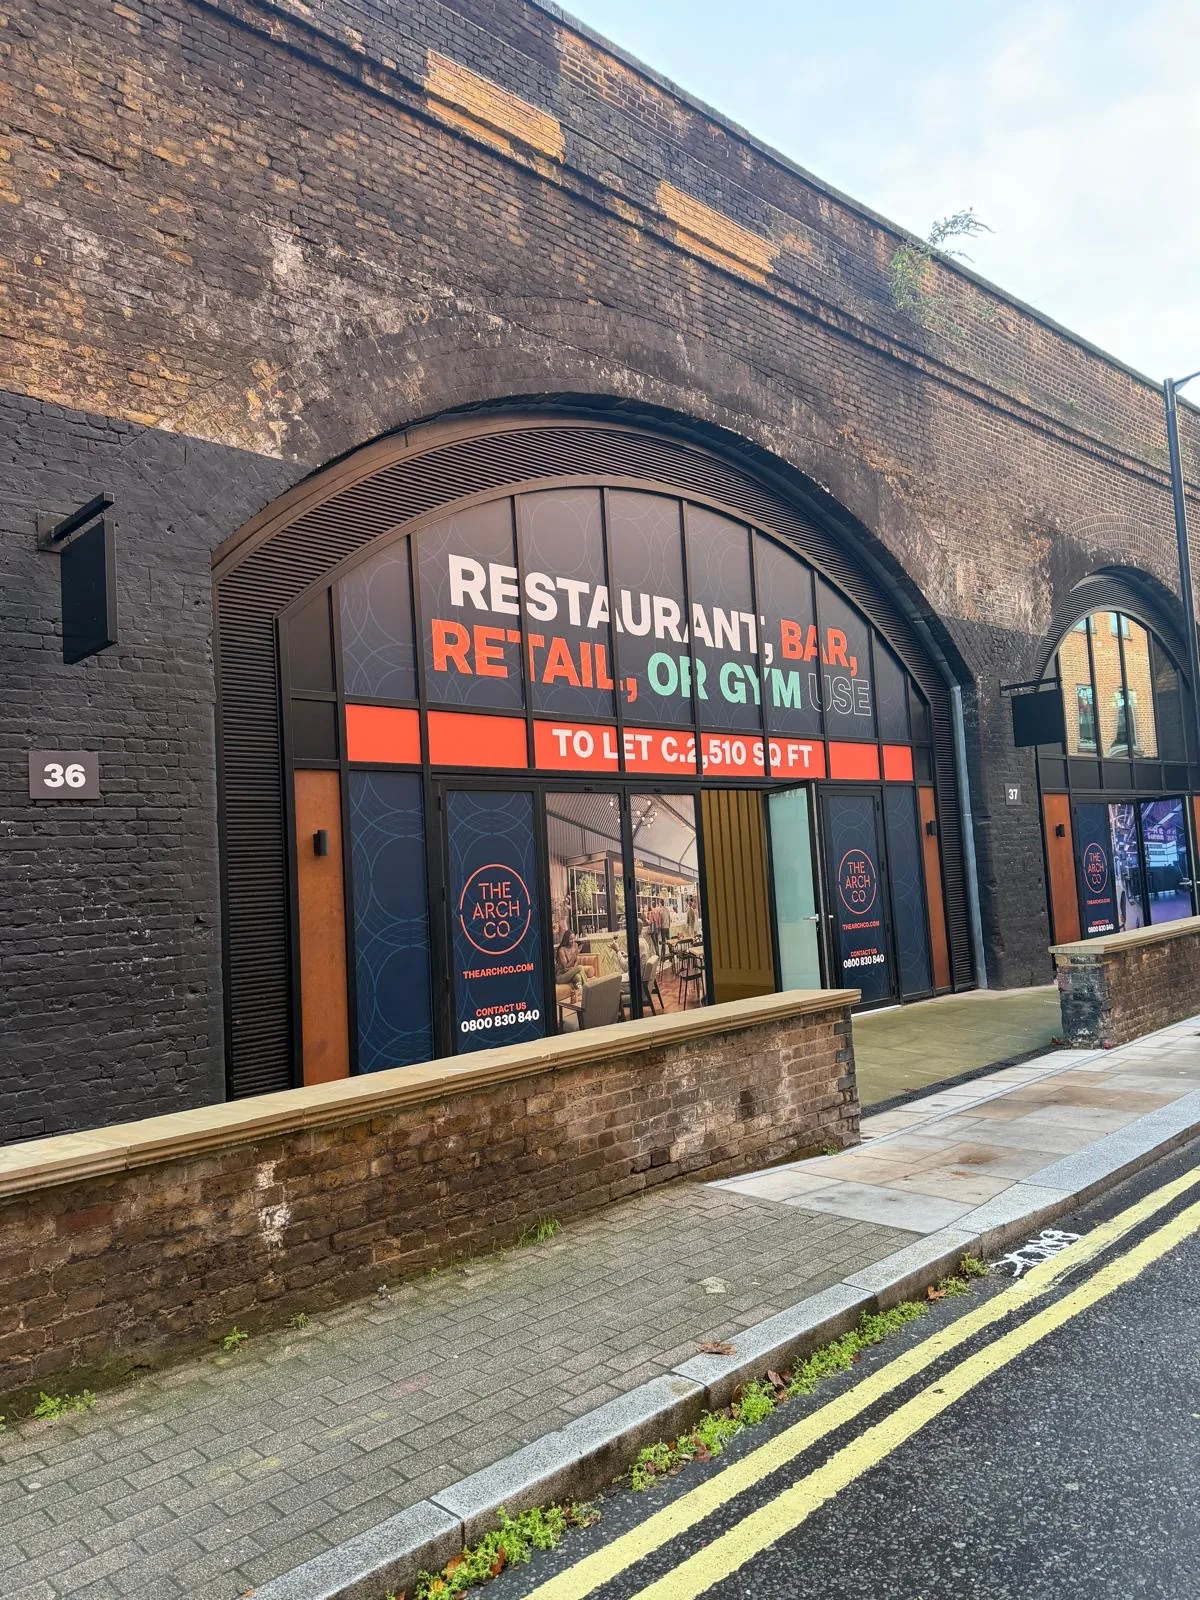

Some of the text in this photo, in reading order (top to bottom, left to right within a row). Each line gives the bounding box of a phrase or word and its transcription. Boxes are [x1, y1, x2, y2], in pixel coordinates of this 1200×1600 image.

[448, 554, 858, 677] RESTAURANT, BAR,
[431, 618, 872, 717] RETAIL, OR GYM USE
[552, 728, 813, 769] TO LET C.2,510 SQ FT
[43, 763, 86, 788] 36
[1008, 788, 1018, 800] 37
[1089, 852, 1101, 862] THE
[847, 861, 866, 874] THE
[1088, 863, 1104, 874] ARCH
[845, 875, 871, 889] ARCH
[1092, 873, 1102, 884] CO
[478, 881, 512, 900] THE
[851, 889, 866, 903] CO
[473, 900, 520, 920] ARCH
[484, 920, 510, 939] CO
[843, 953, 885, 968] 0800 830 840
[463, 963, 534, 979] THEARCHCO.COM
[476, 1001, 527, 1017] CONTACT US
[461, 1009, 540, 1033] 0800 830 840
